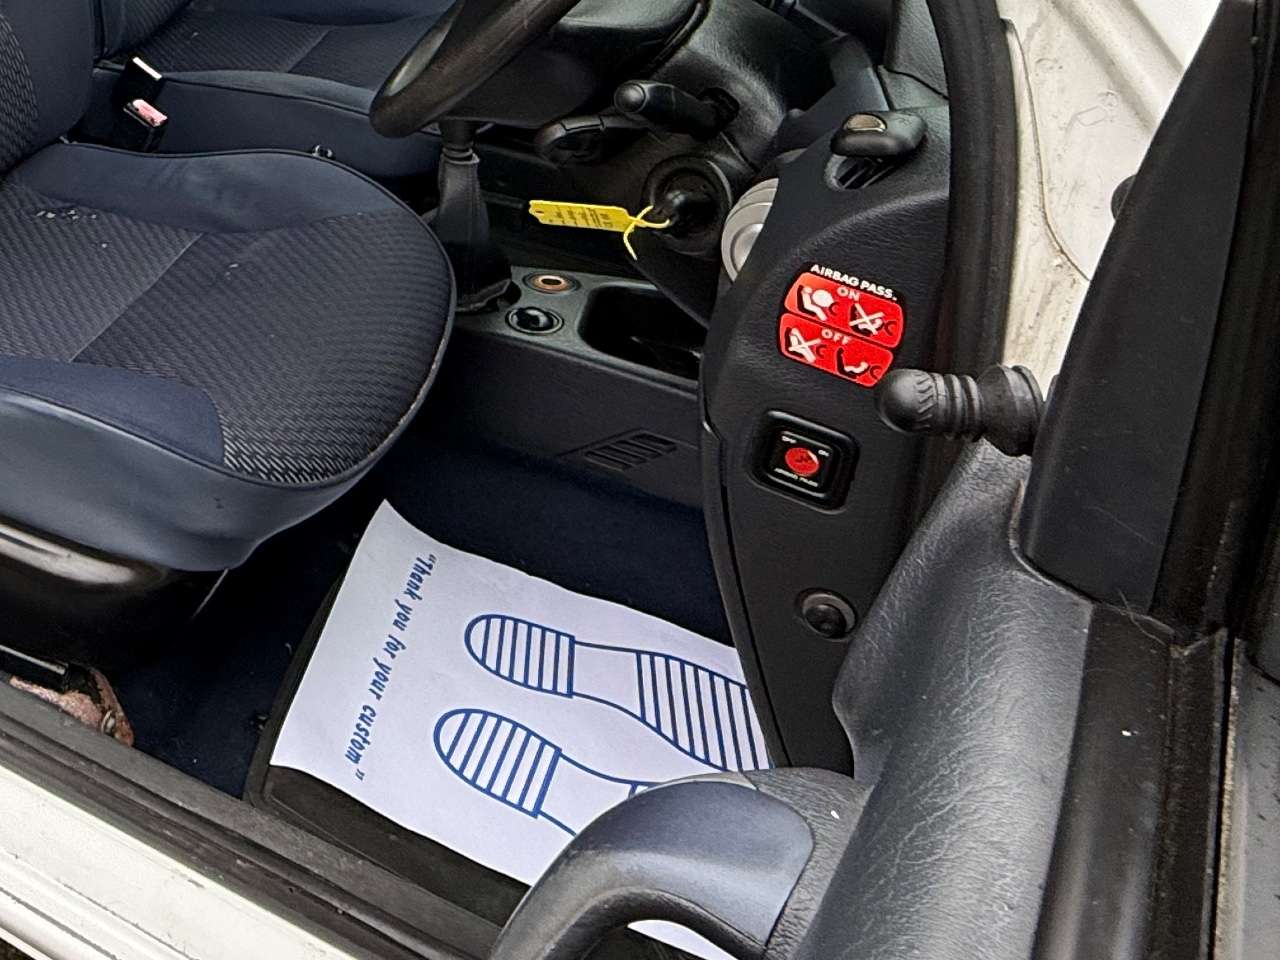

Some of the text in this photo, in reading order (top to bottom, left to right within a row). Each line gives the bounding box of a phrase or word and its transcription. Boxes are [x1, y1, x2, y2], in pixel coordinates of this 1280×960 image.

[810, 264, 897, 301] AIRBAG PASS.
[837, 286, 860, 301] ON
[821, 328, 852, 344] OFF
[403, 554, 437, 600] "Thank
[393, 599, 413, 631] you
[383, 634, 406, 659] for
[368, 657, 392, 701] your
